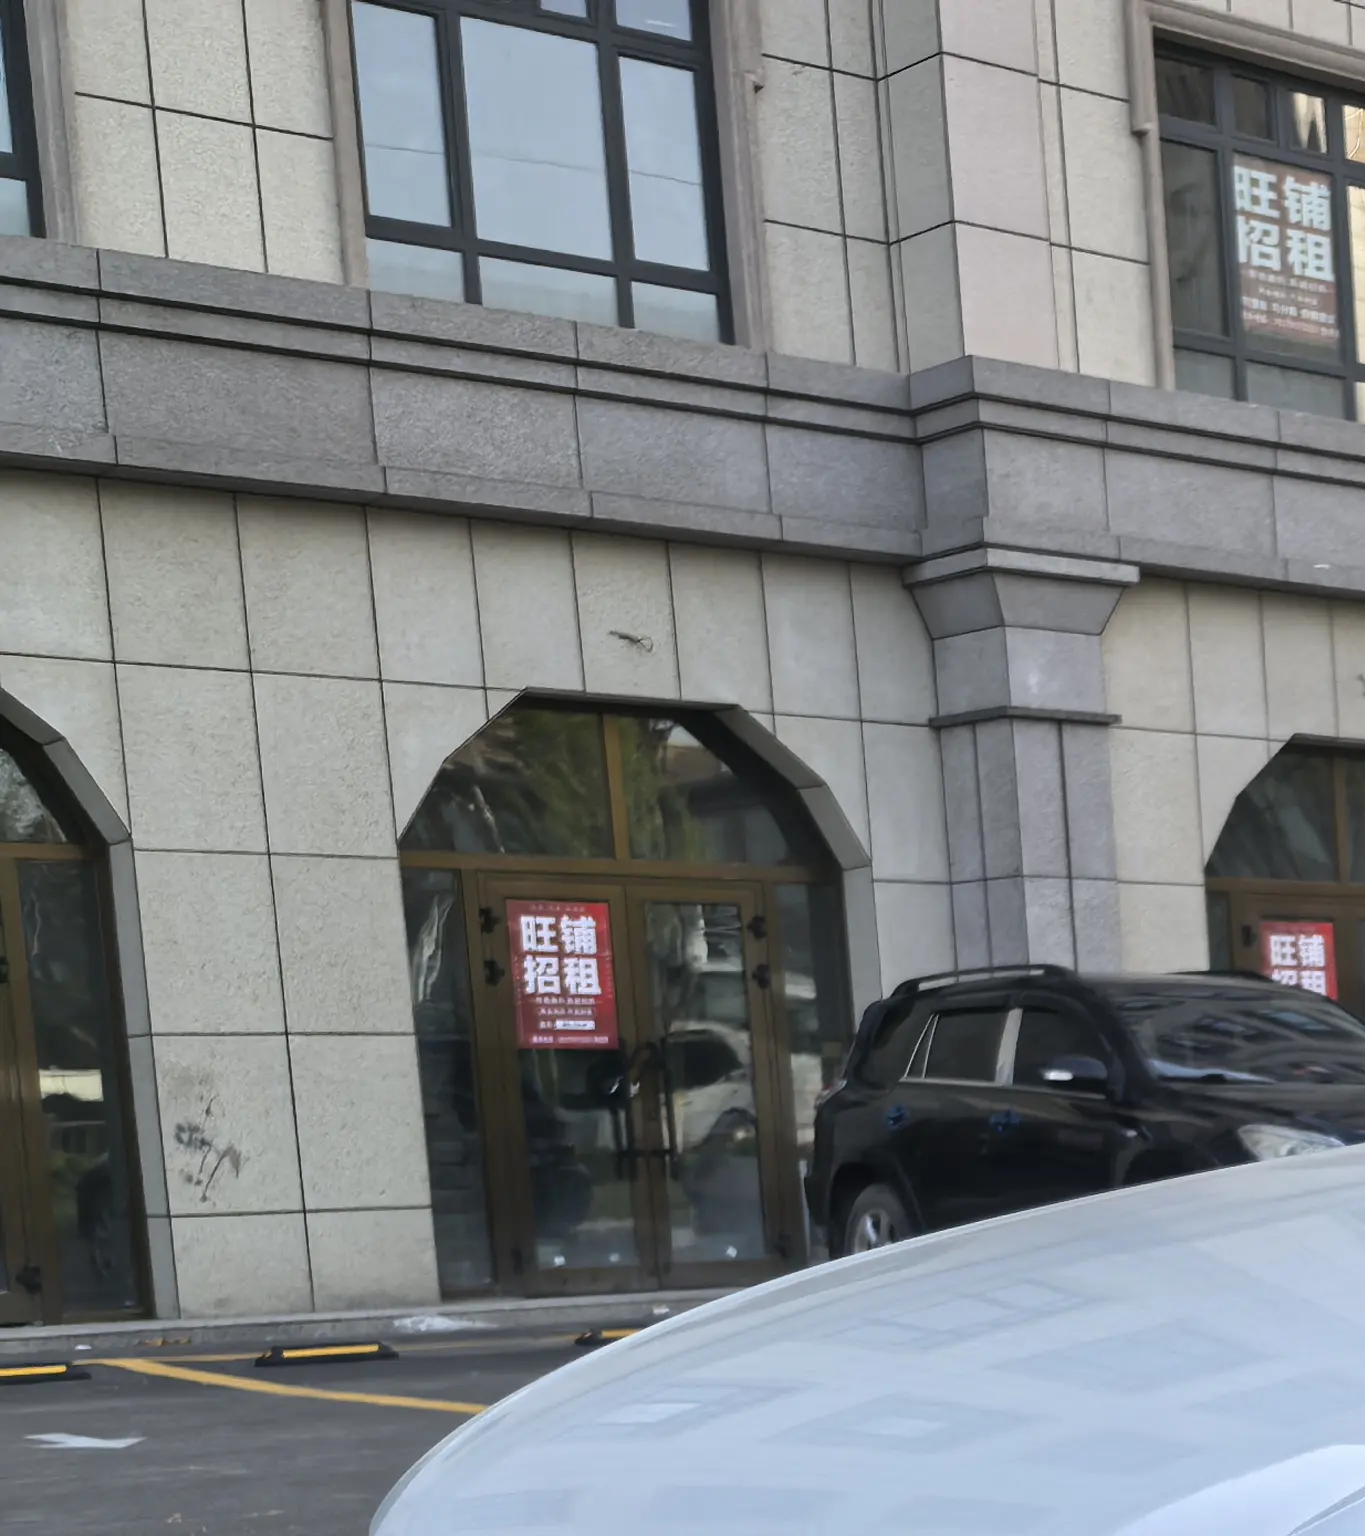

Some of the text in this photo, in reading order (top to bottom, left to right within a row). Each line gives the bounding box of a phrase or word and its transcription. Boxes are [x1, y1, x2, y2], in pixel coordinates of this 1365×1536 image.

[1234, 164, 1332, 232] 旺铺
[1237, 215, 1336, 283] 招租
[520, 914, 597, 955] 旺铺
[1269, 933, 1326, 968] 旺铺
[523, 954, 602, 995] 招租
